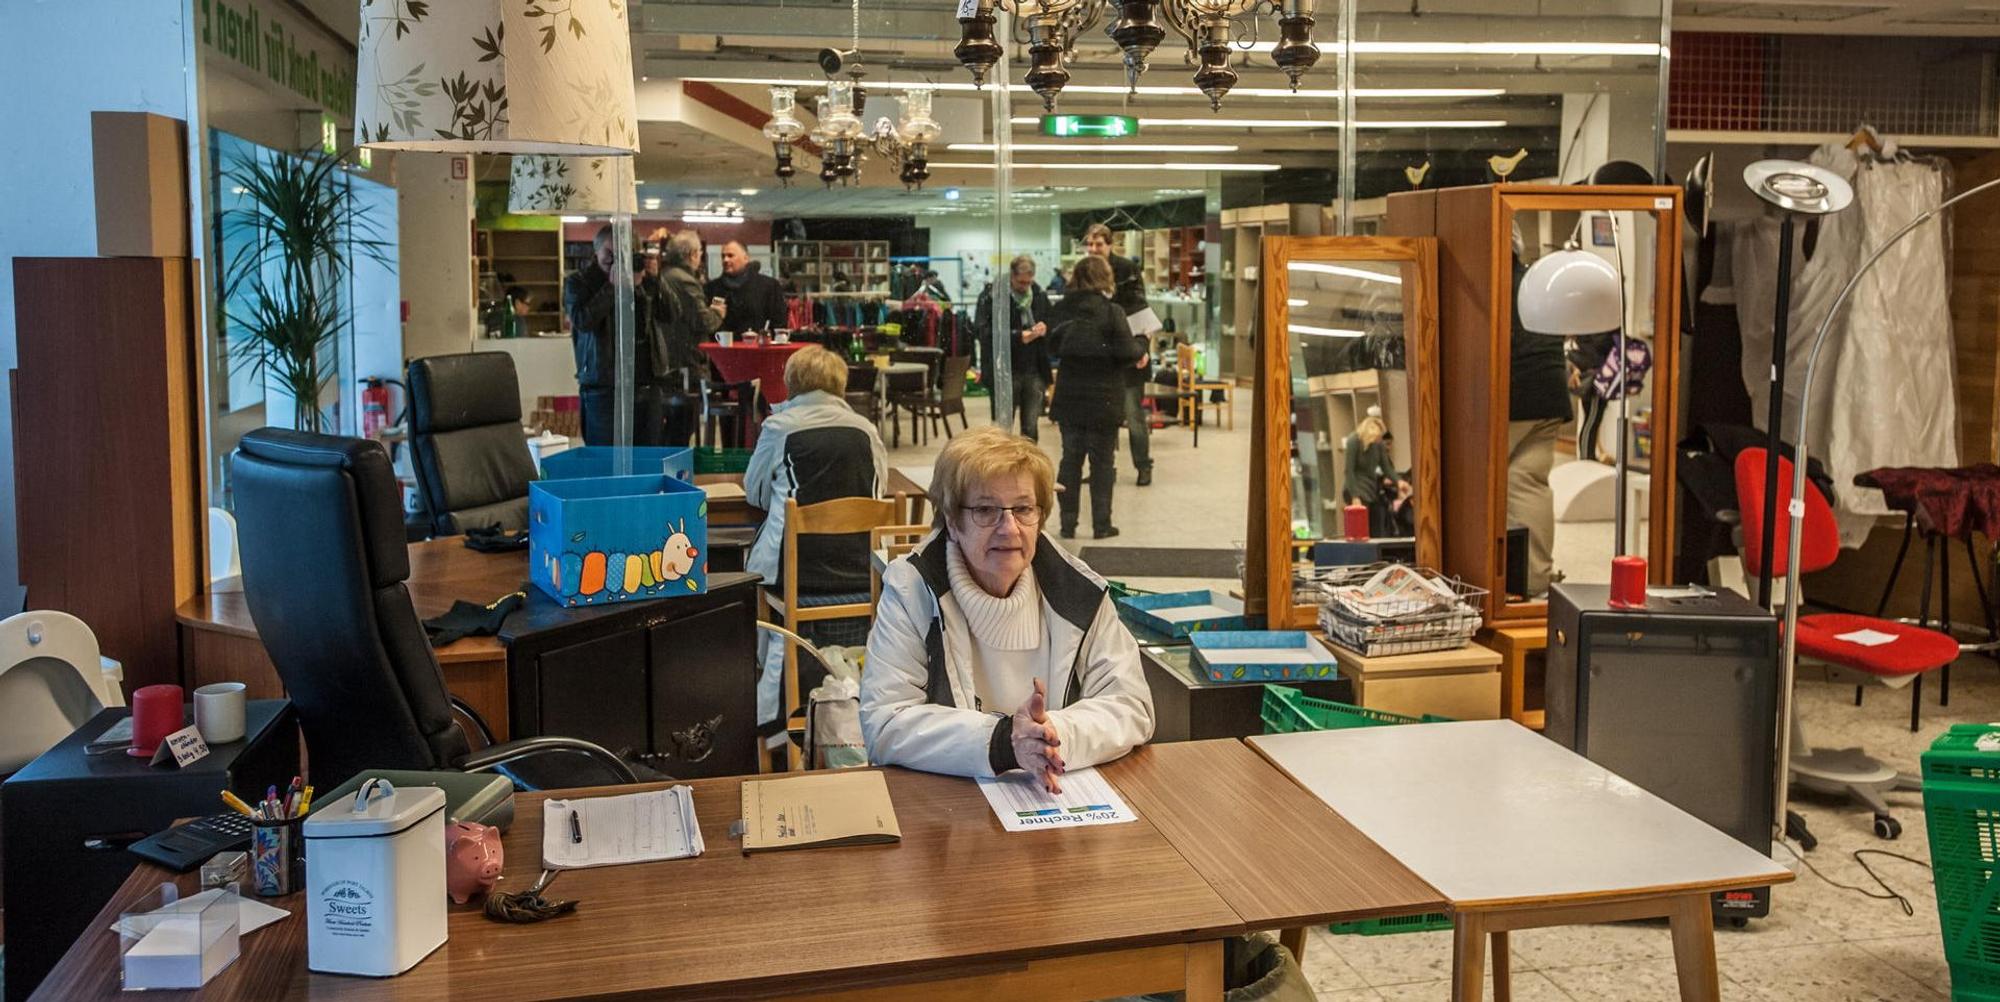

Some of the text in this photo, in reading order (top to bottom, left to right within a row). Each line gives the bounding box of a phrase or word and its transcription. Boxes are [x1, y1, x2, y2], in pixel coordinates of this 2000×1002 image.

[1019, 811, 1119, 826] 20% Rechner
[329, 901, 367, 915] Sweets
